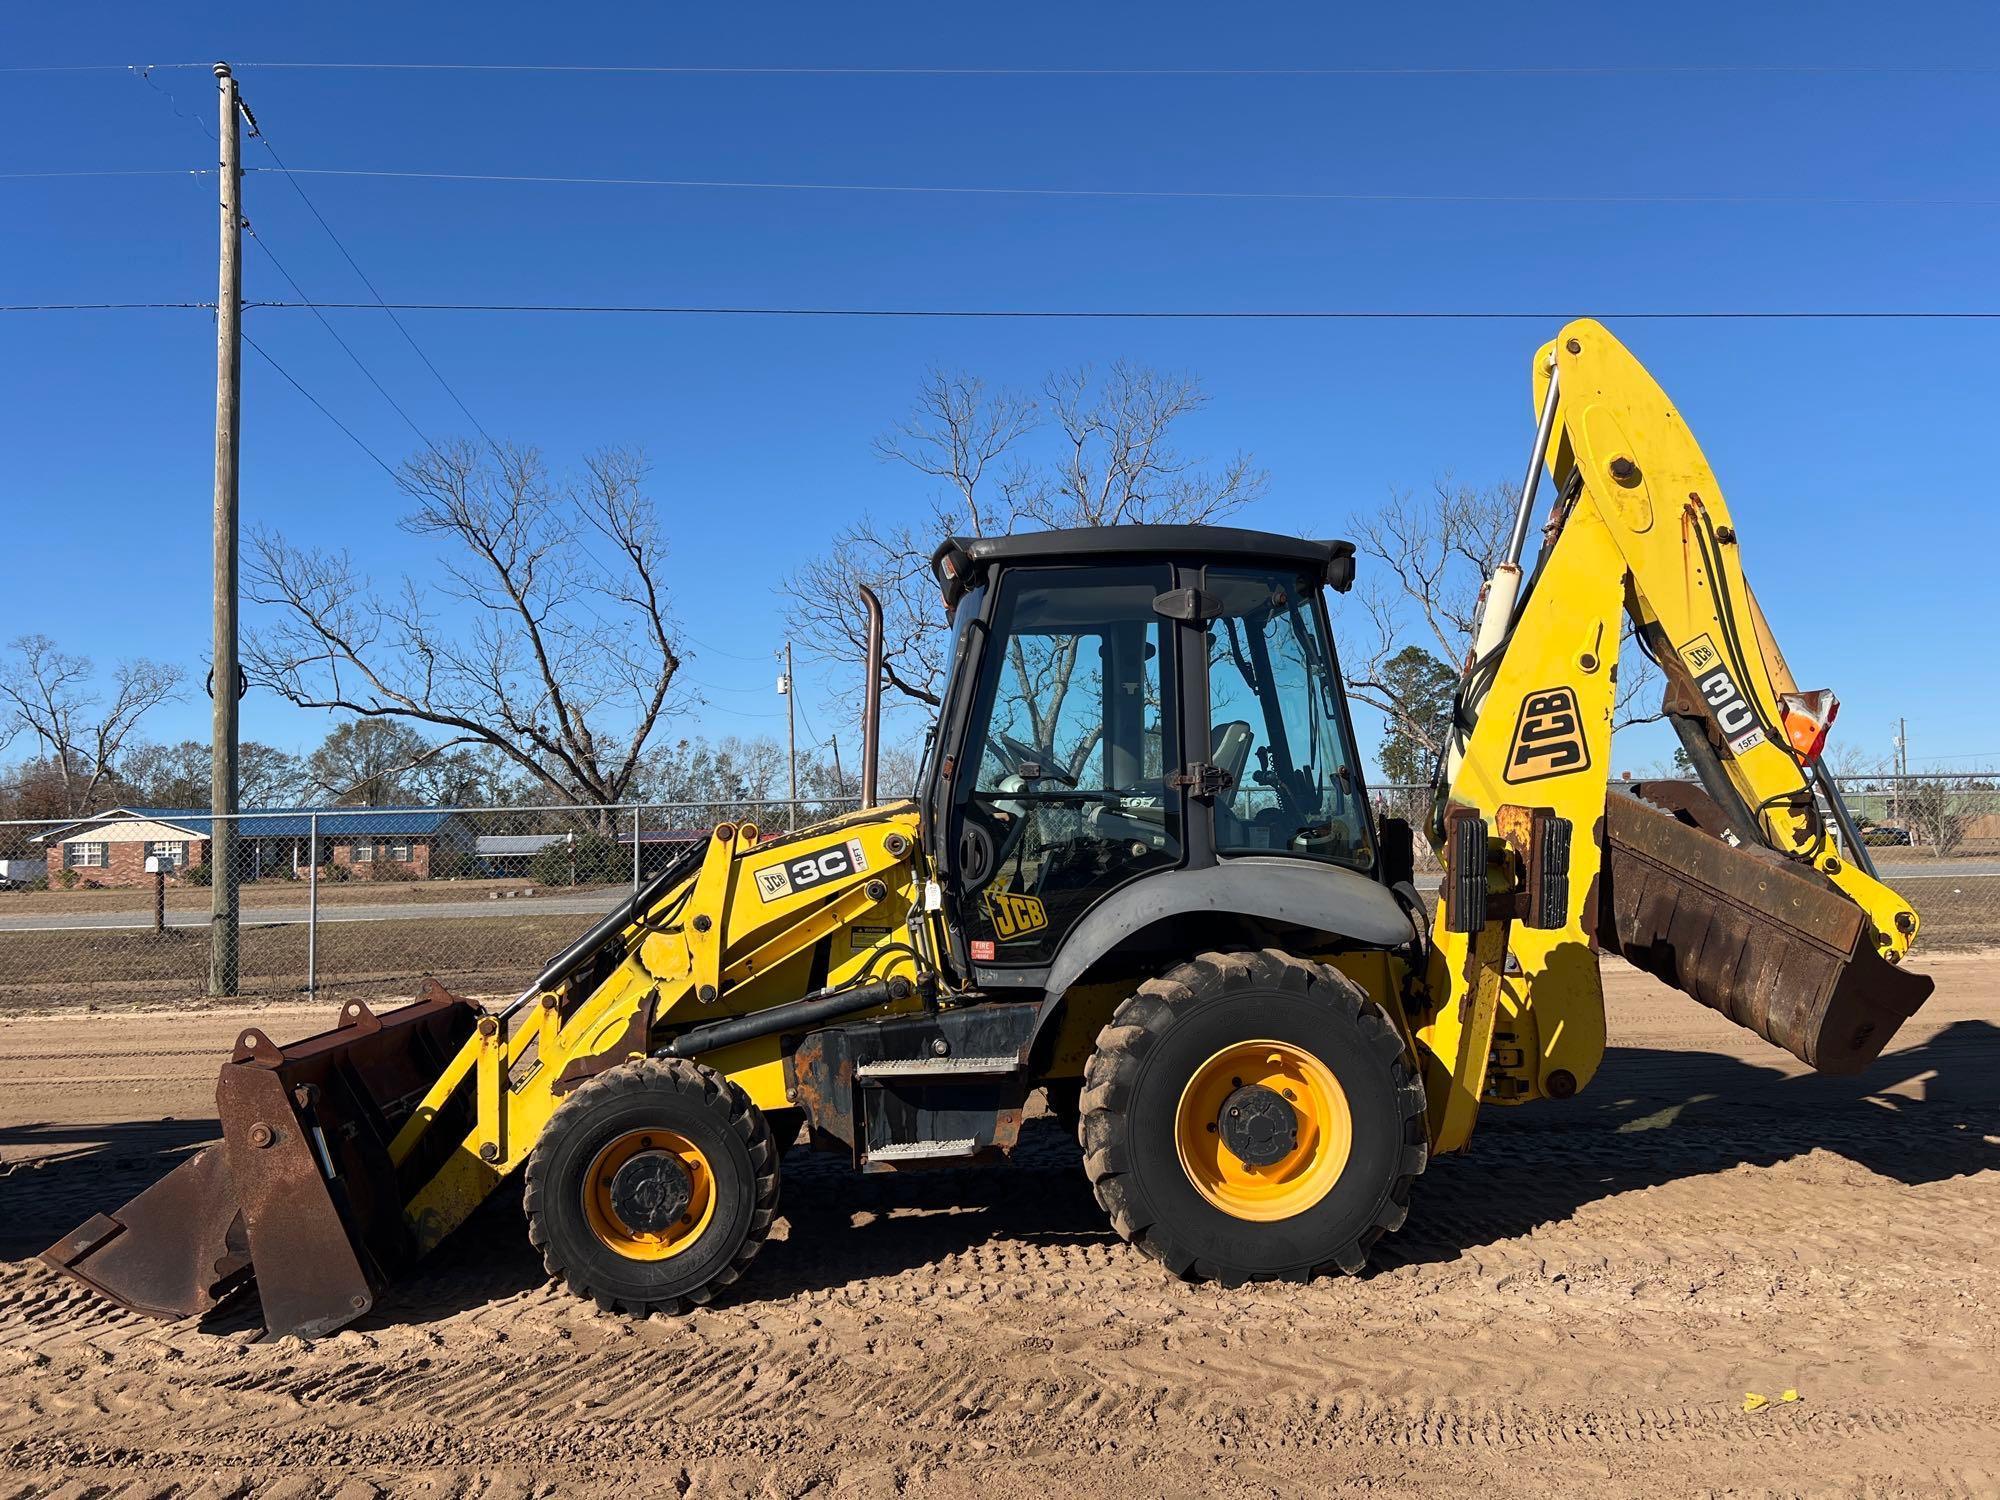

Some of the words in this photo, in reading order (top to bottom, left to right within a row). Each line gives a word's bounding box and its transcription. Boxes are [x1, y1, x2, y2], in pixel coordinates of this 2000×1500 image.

[1689, 646, 1713, 667] JCB
[1701, 672, 1753, 734] 3C
[1737, 733, 1759, 750] 15FT
[1514, 692, 1581, 769] JCB
[763, 873, 787, 894] JCB
[791, 850, 848, 885] 3C
[853, 847, 865, 867] 15FT
[996, 894, 1045, 935] JCB
